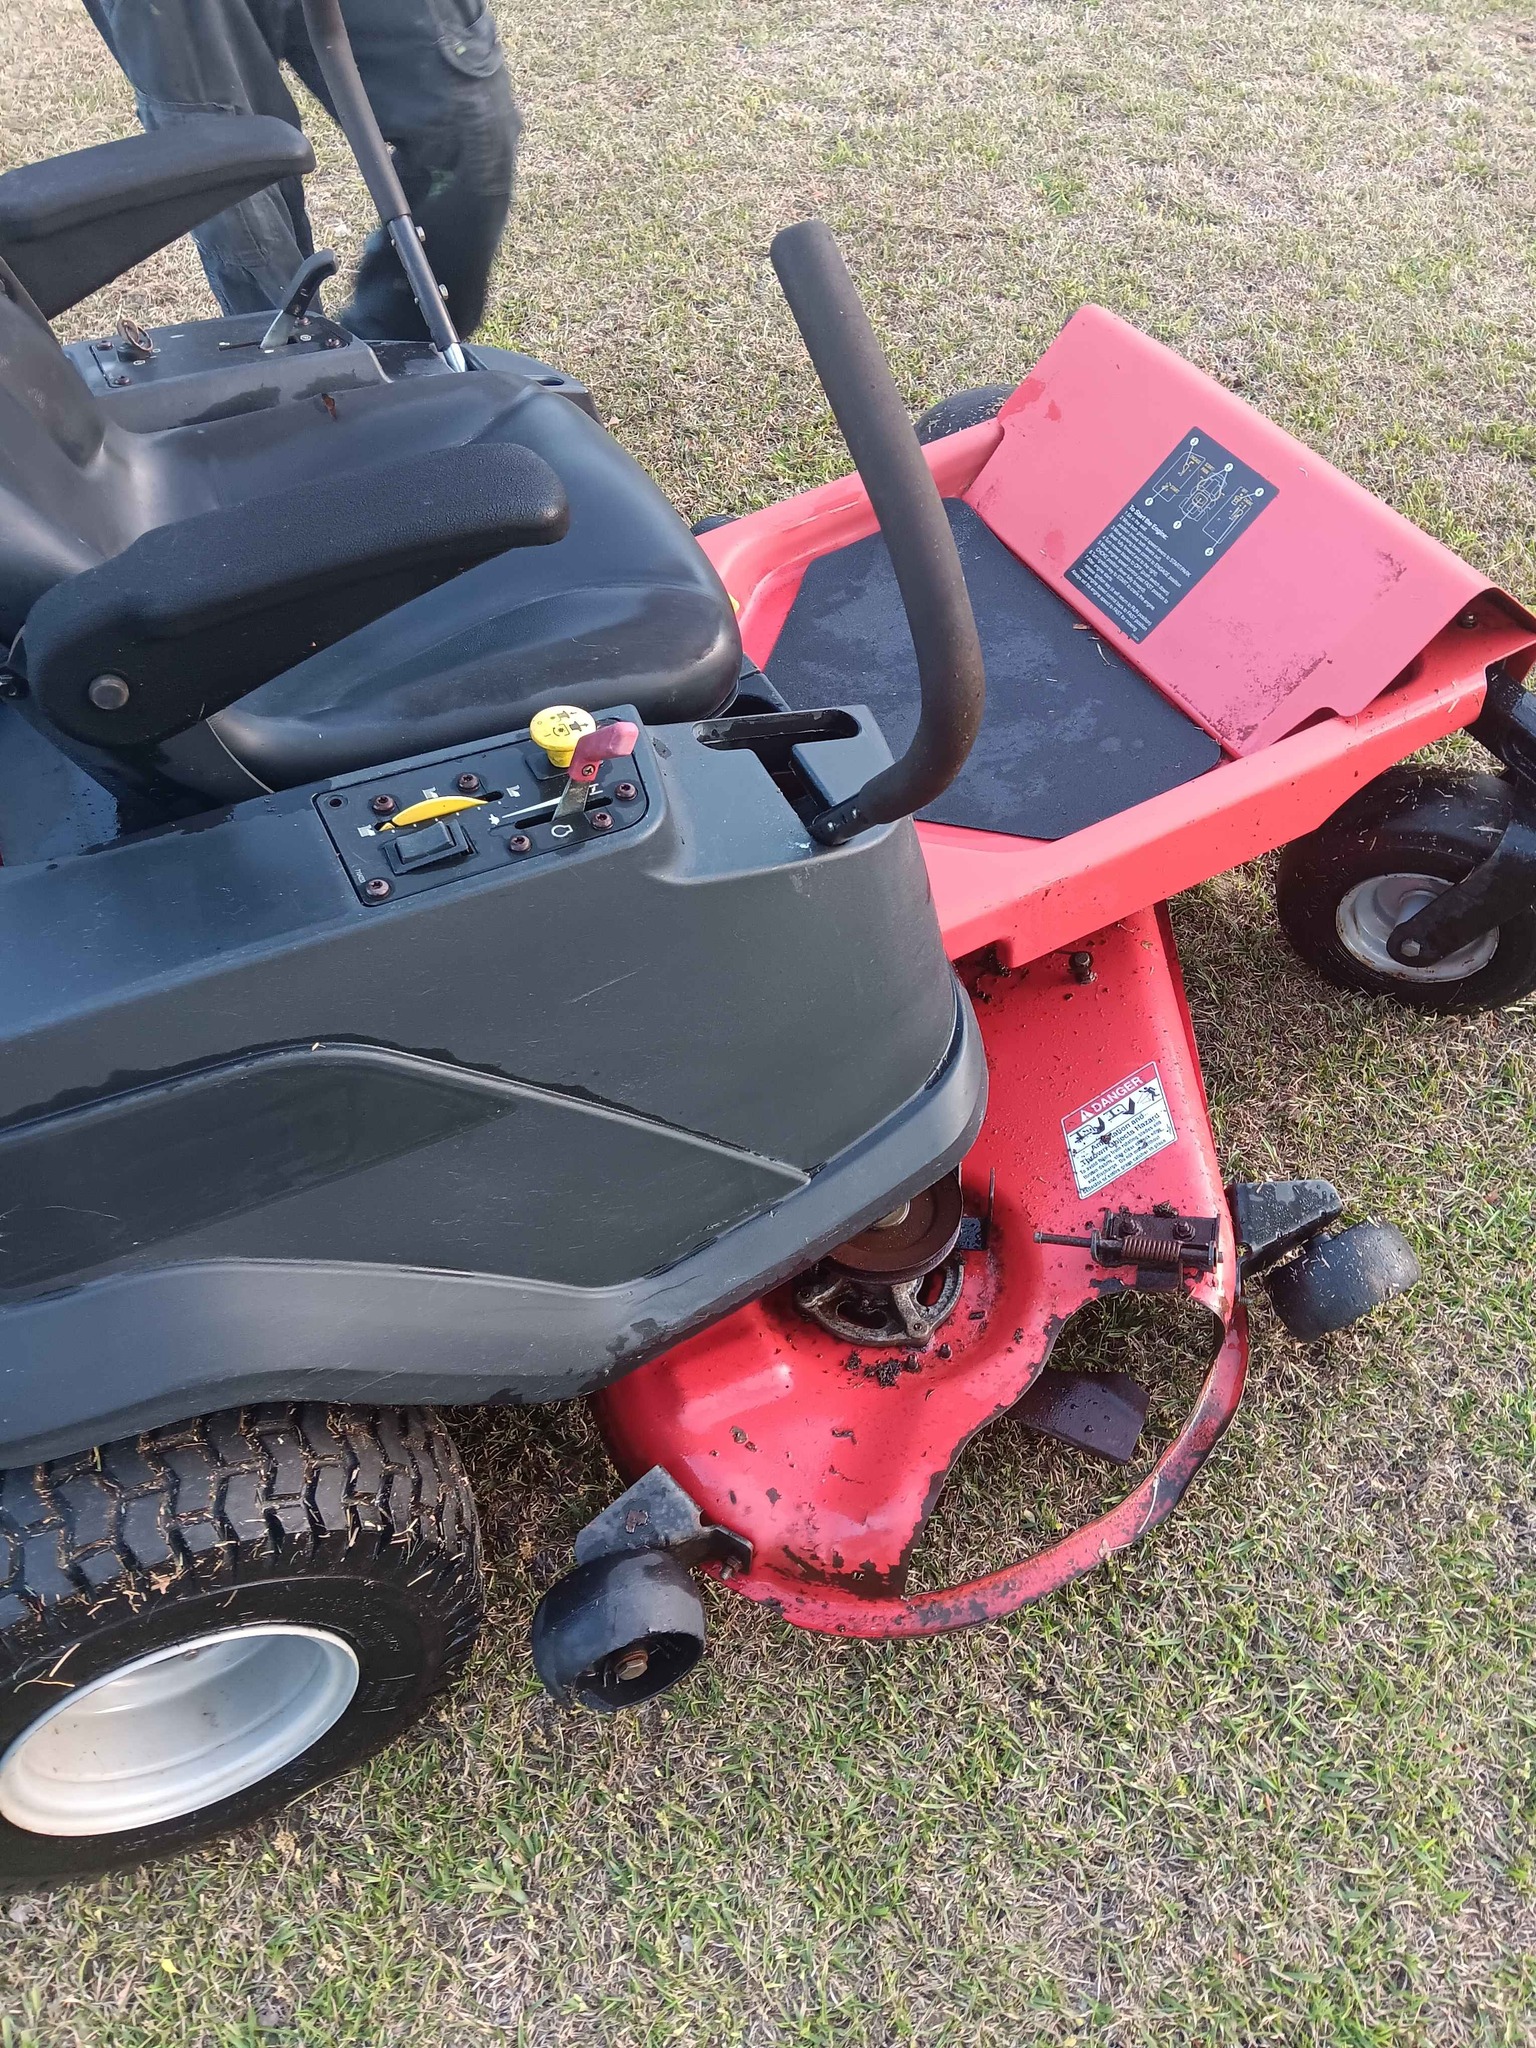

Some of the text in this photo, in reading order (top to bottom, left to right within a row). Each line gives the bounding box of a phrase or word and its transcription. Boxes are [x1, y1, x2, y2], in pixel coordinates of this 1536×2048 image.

[1091, 1076, 1144, 1113] DANGER
[1134, 1112, 1160, 1131] Hazard
[1091, 1122, 1130, 1149] Amation
